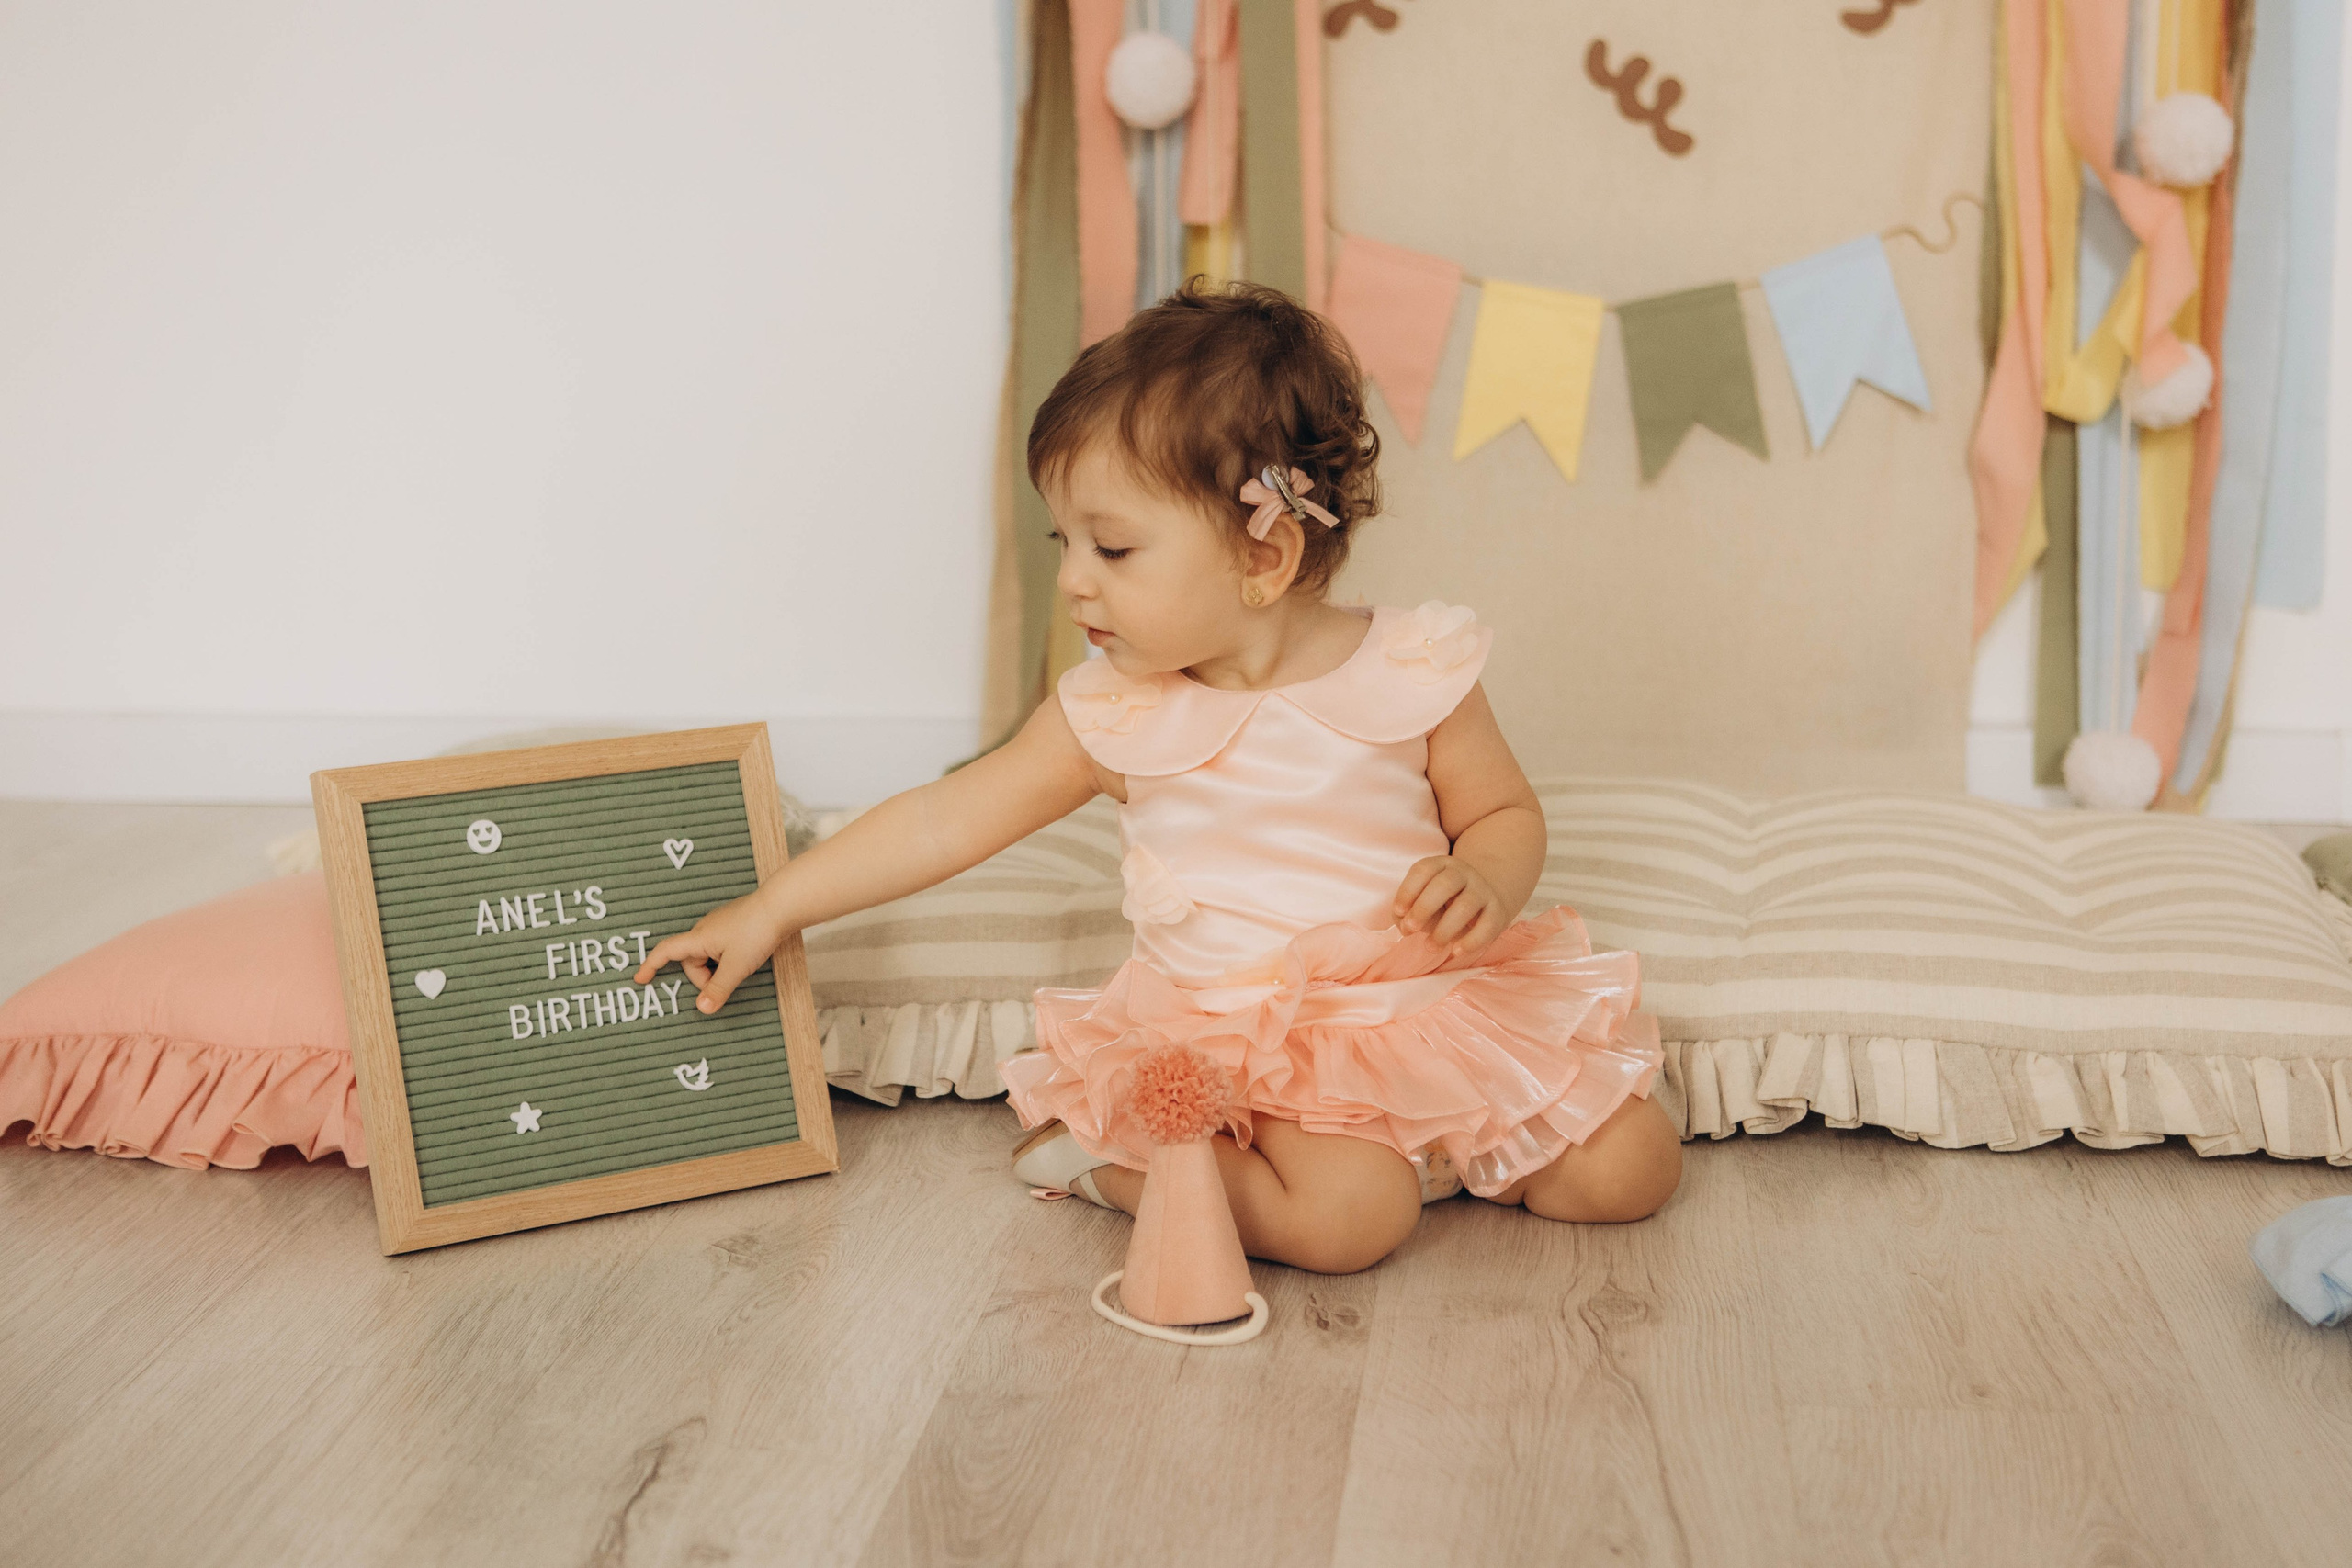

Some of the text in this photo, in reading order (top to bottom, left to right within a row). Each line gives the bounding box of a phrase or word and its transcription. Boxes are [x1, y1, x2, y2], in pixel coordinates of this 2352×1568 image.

[476, 886, 607, 936] ANEL'S
[546, 931, 650, 980] FIRST
[509, 979, 682, 1040] BIRTHDAY
